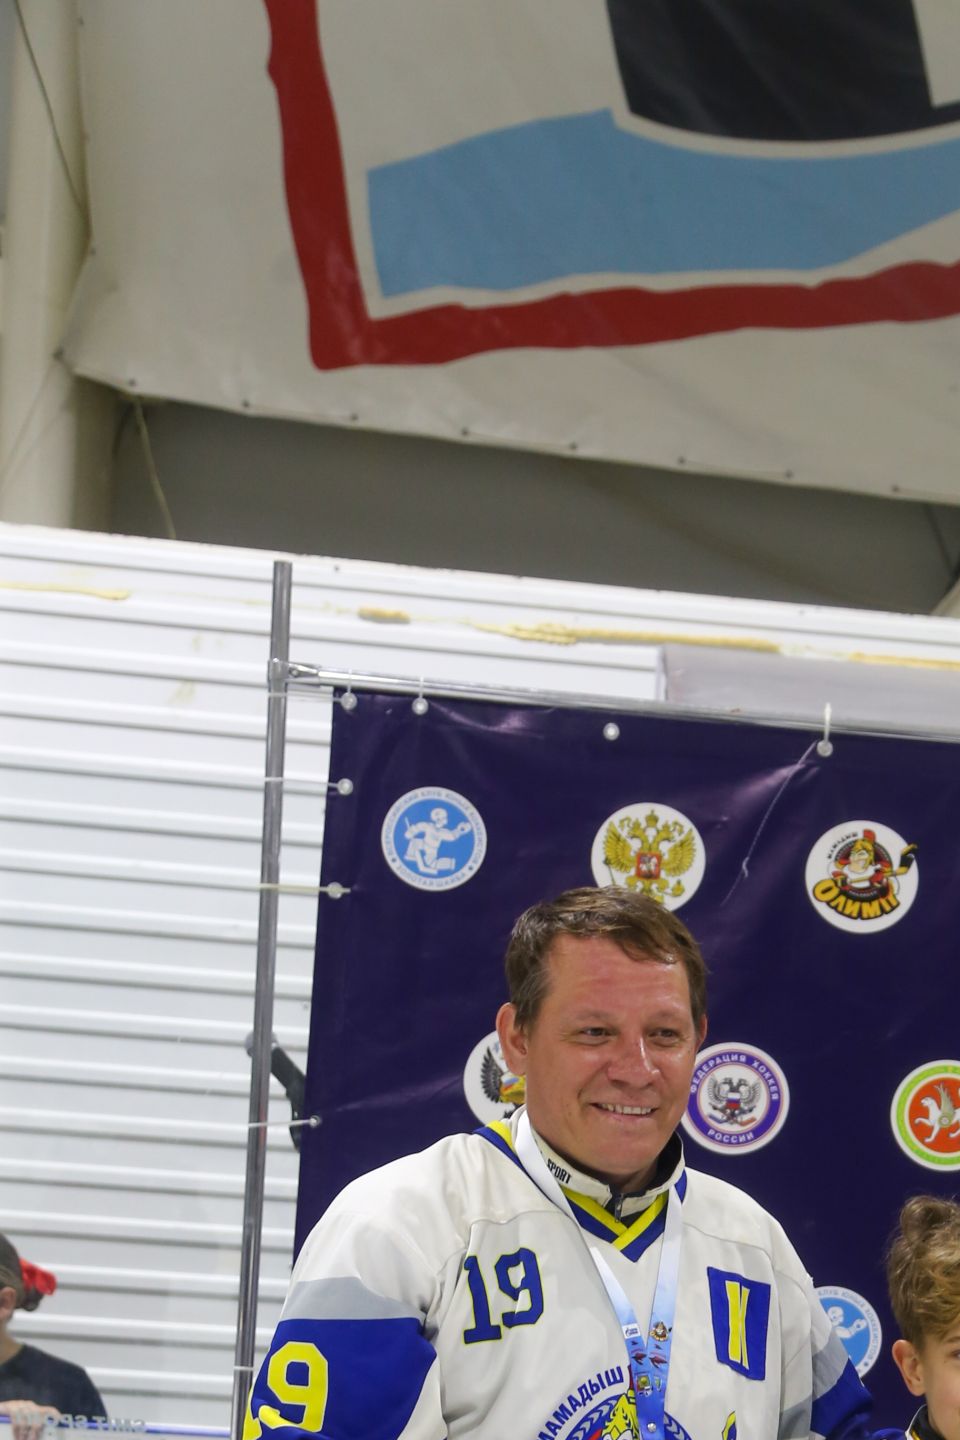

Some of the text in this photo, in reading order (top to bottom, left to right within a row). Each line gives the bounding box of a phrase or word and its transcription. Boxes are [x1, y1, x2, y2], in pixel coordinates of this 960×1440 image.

[690, 1054, 779, 1100] ФЕДЕРАЦИЯ ХОККЕЯ
[707, 1128, 754, 1143] РОССИИ
[463, 1247, 545, 1345] 19
